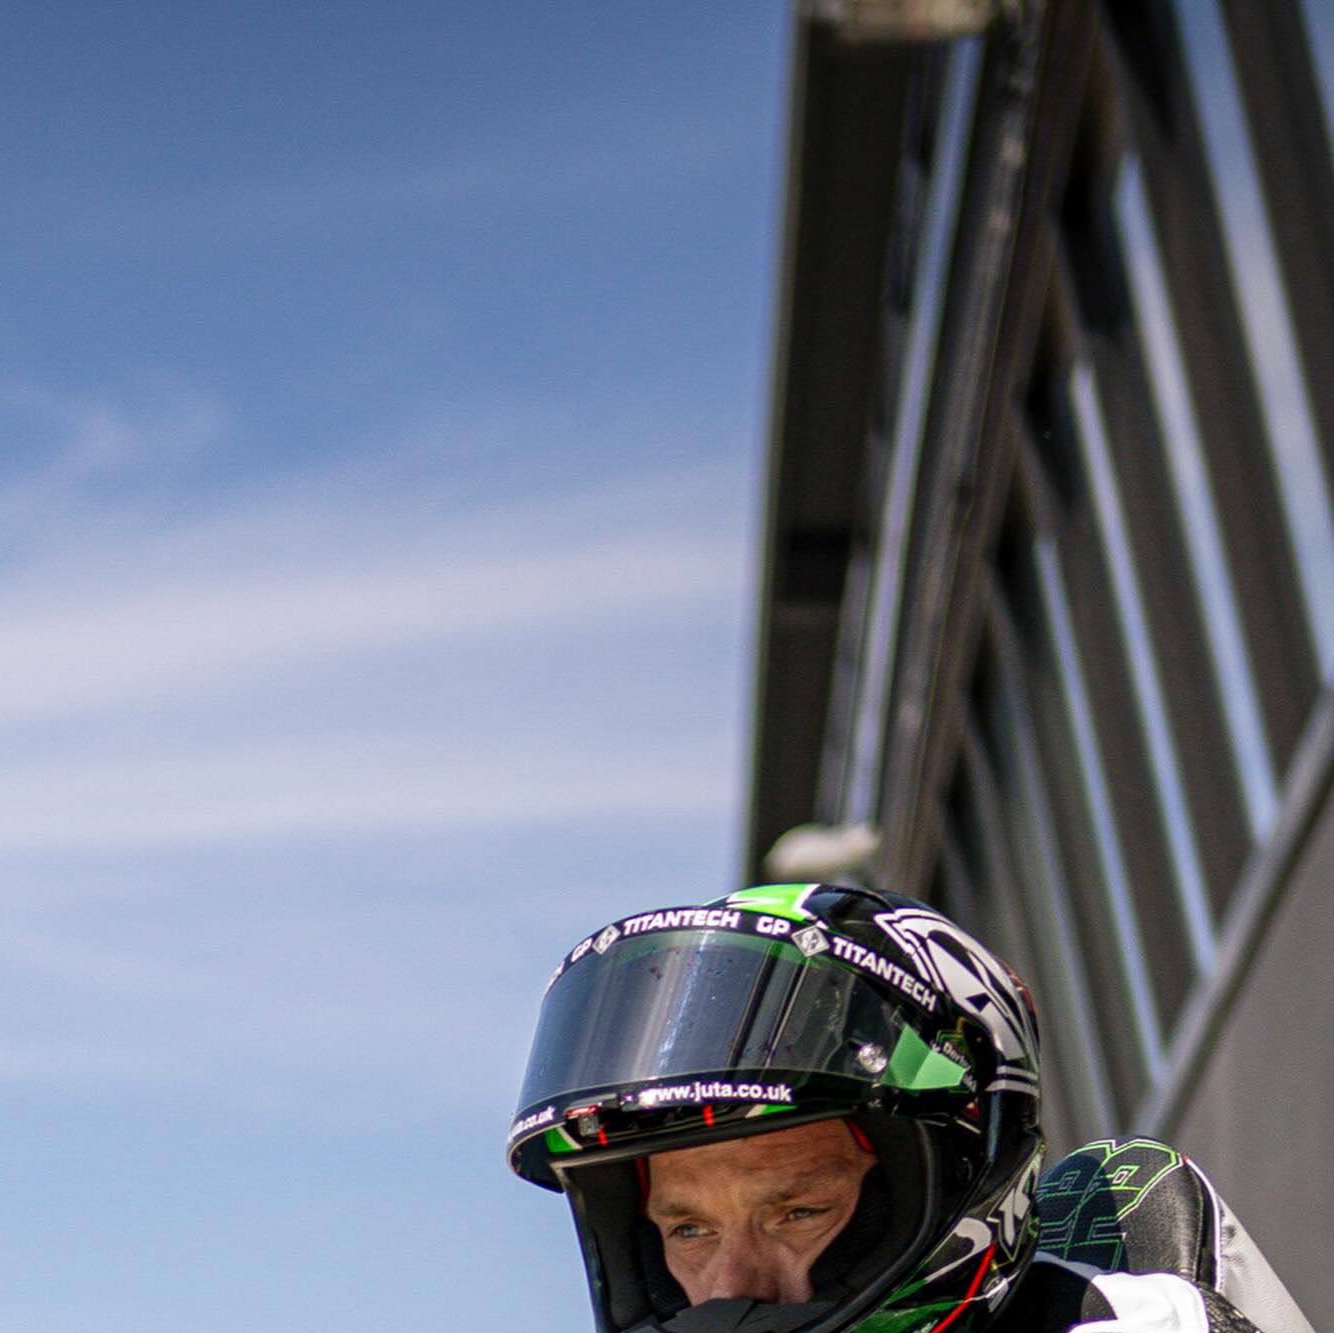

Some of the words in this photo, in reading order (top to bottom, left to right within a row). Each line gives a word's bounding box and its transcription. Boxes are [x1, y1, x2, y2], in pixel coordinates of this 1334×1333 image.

[624, 909, 740, 936] TITANTECH
[756, 916, 791, 935] GP
[571, 938, 593, 963] GP
[831, 936, 937, 1012] TITANTECH
